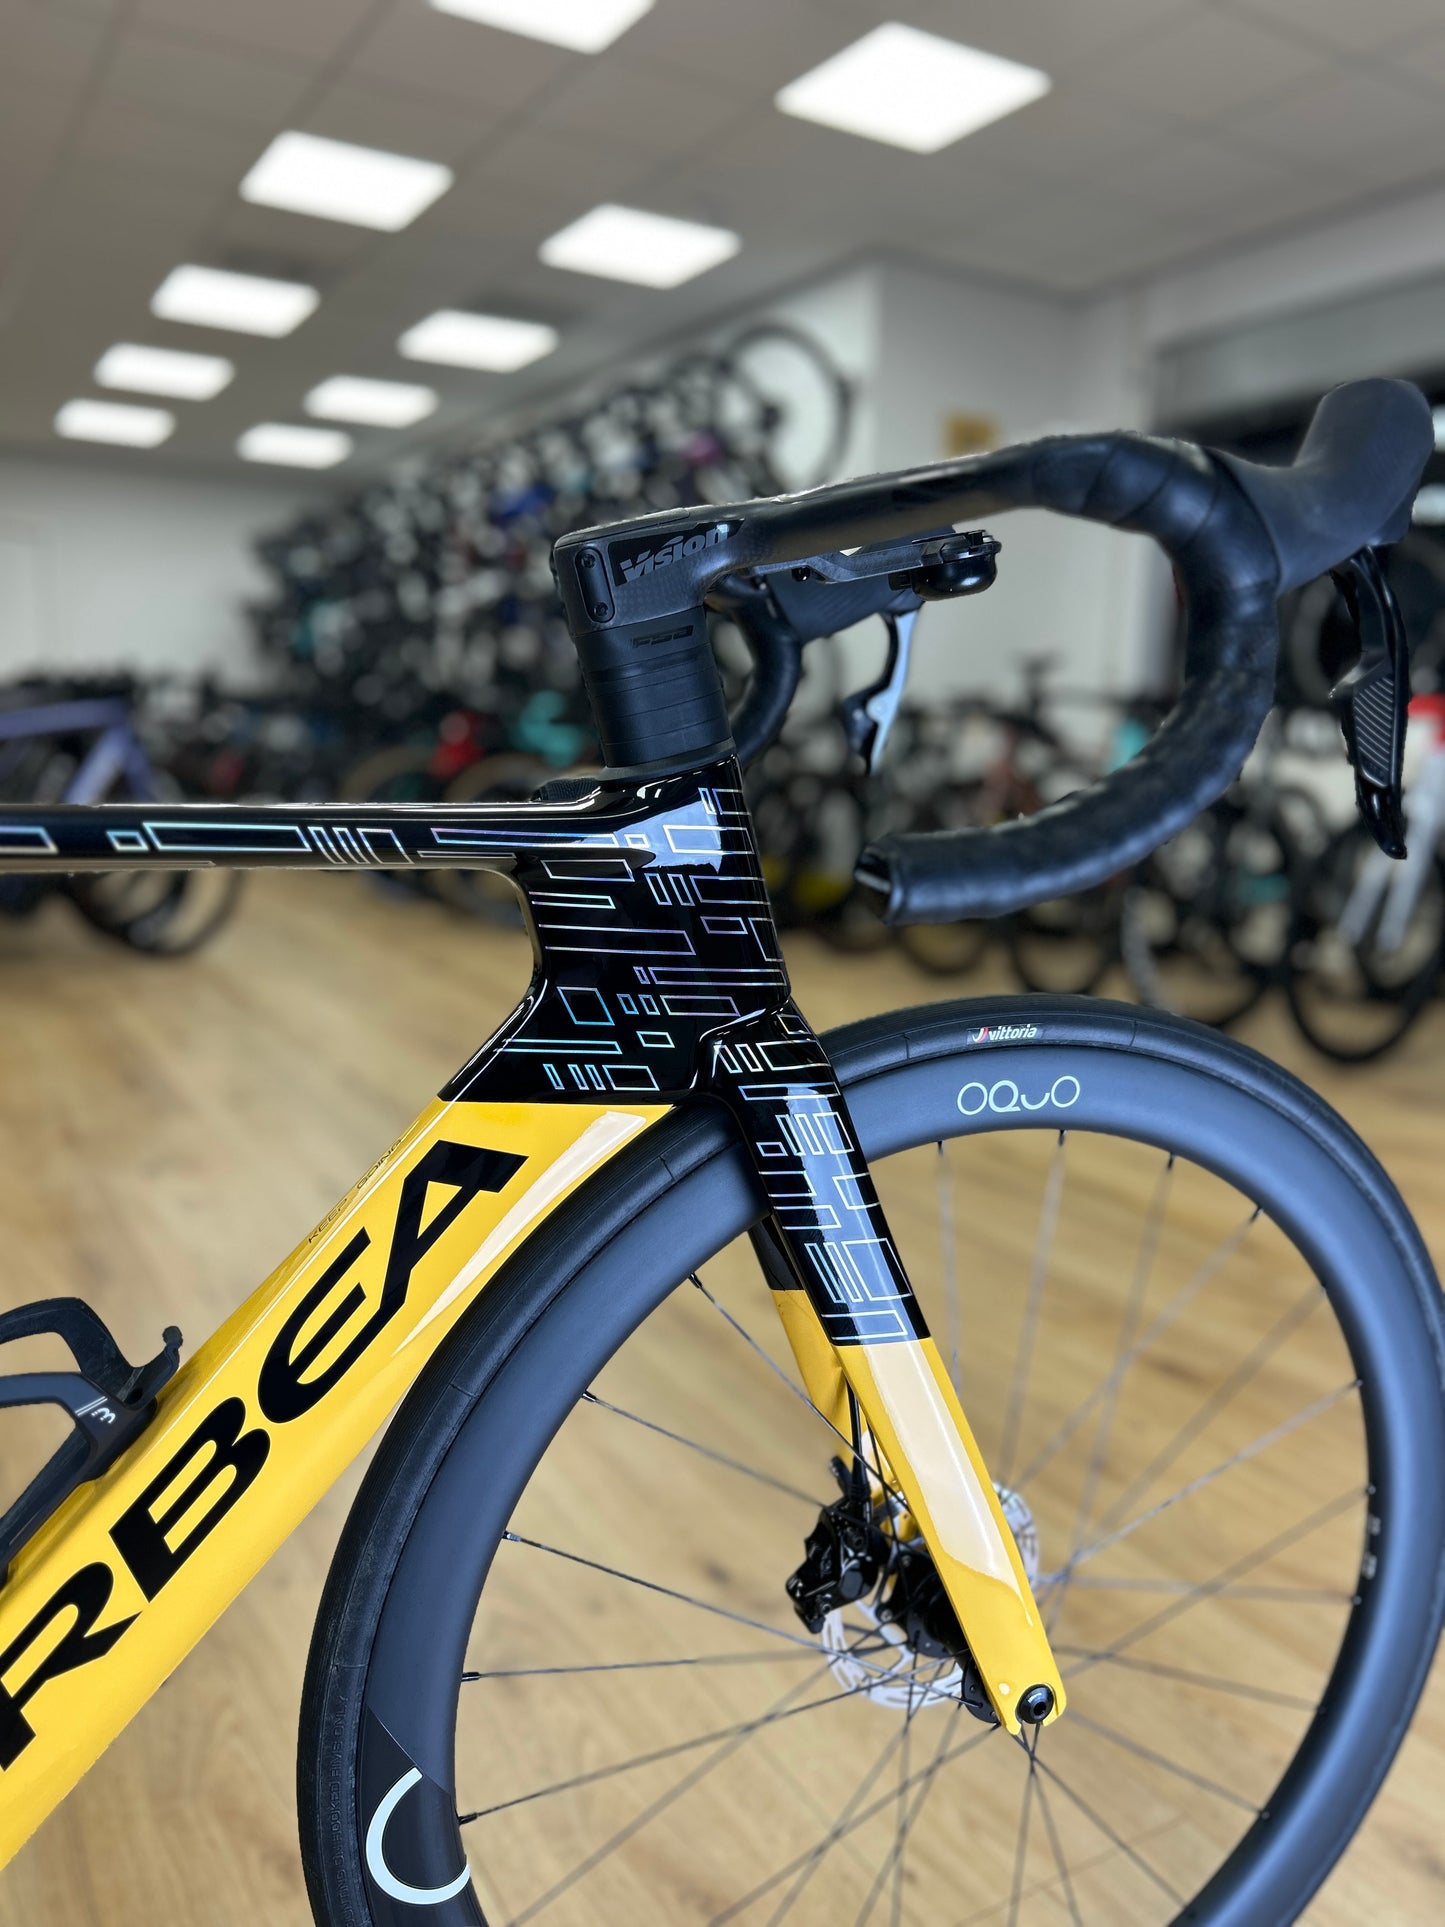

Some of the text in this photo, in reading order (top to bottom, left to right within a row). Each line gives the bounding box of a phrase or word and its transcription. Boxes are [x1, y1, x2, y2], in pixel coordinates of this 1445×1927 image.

[620, 523, 730, 582] Vision
[988, 1023, 1038, 1041] vittoria
[333, 1695, 349, 1737] ONLY
